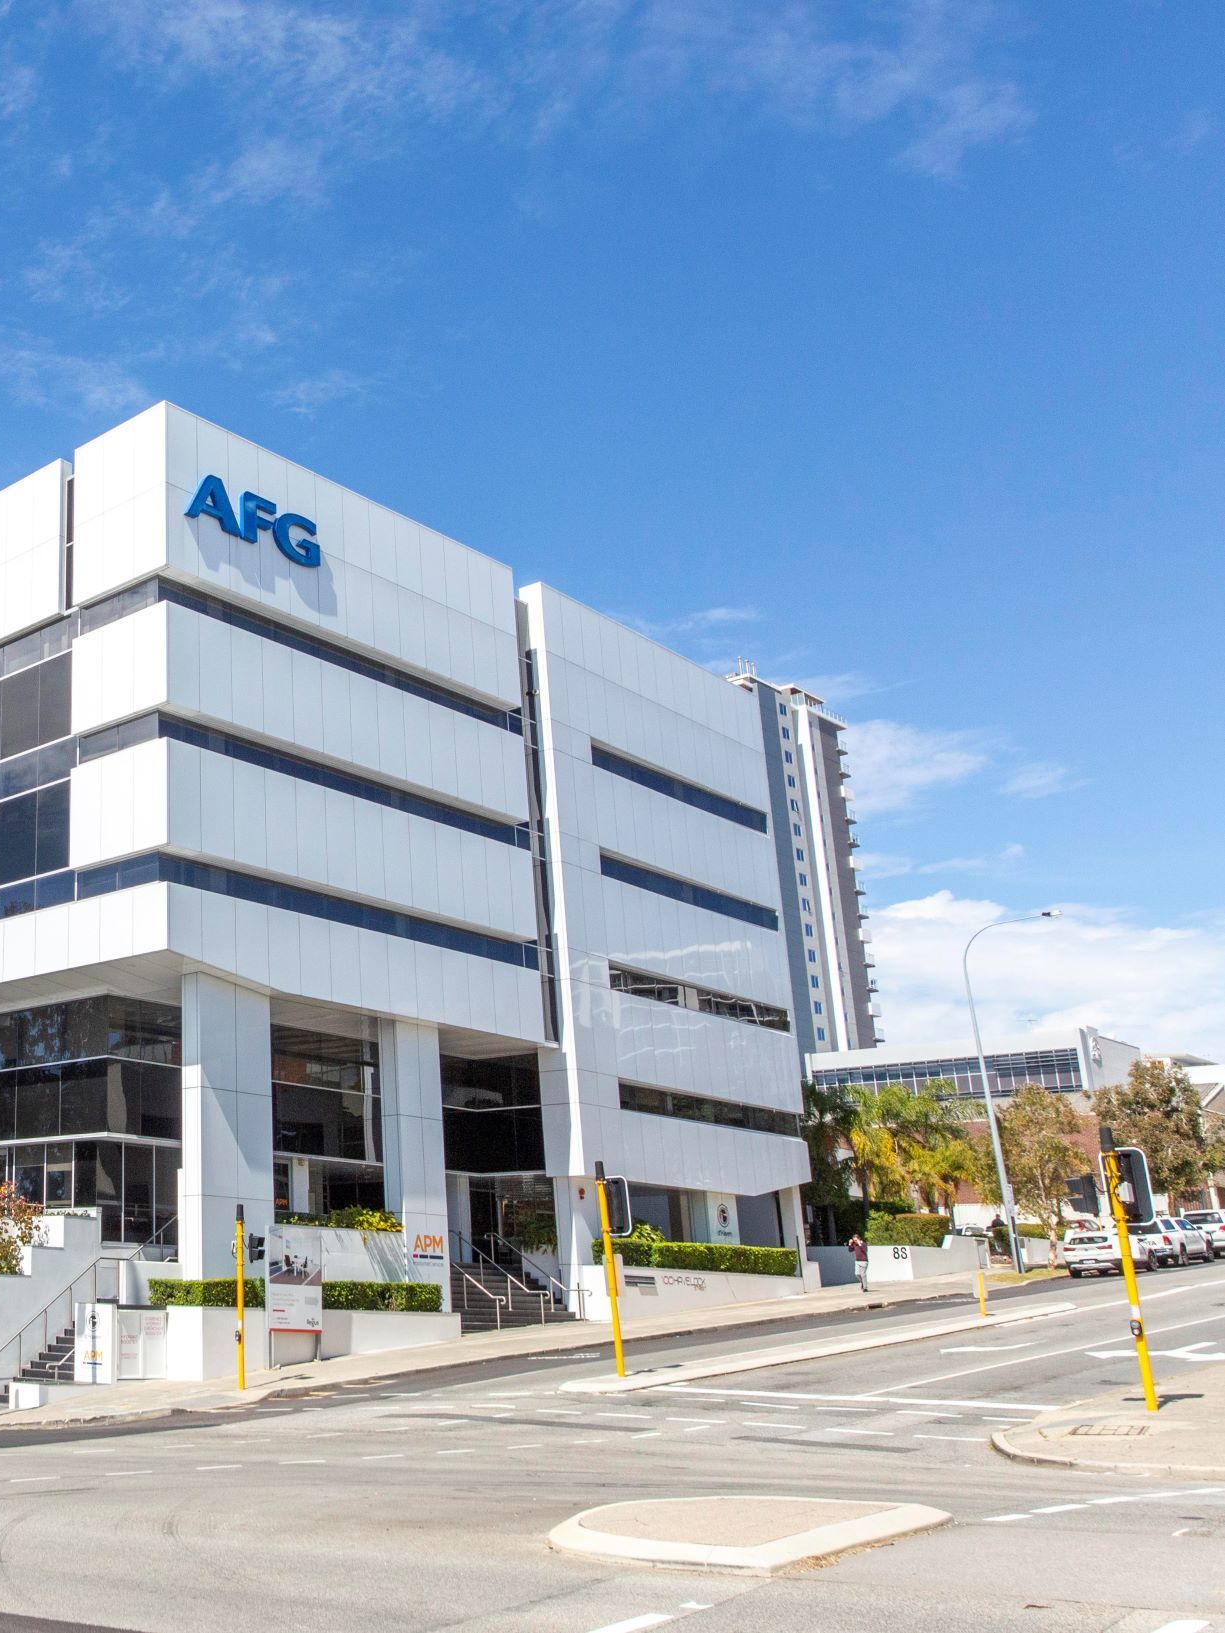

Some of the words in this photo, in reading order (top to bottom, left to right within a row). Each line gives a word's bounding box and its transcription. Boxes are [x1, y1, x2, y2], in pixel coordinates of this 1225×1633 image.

[184, 474, 321, 568] AFG
[413, 1234, 444, 1254] APM
[83, 1350, 104, 1361] APM
